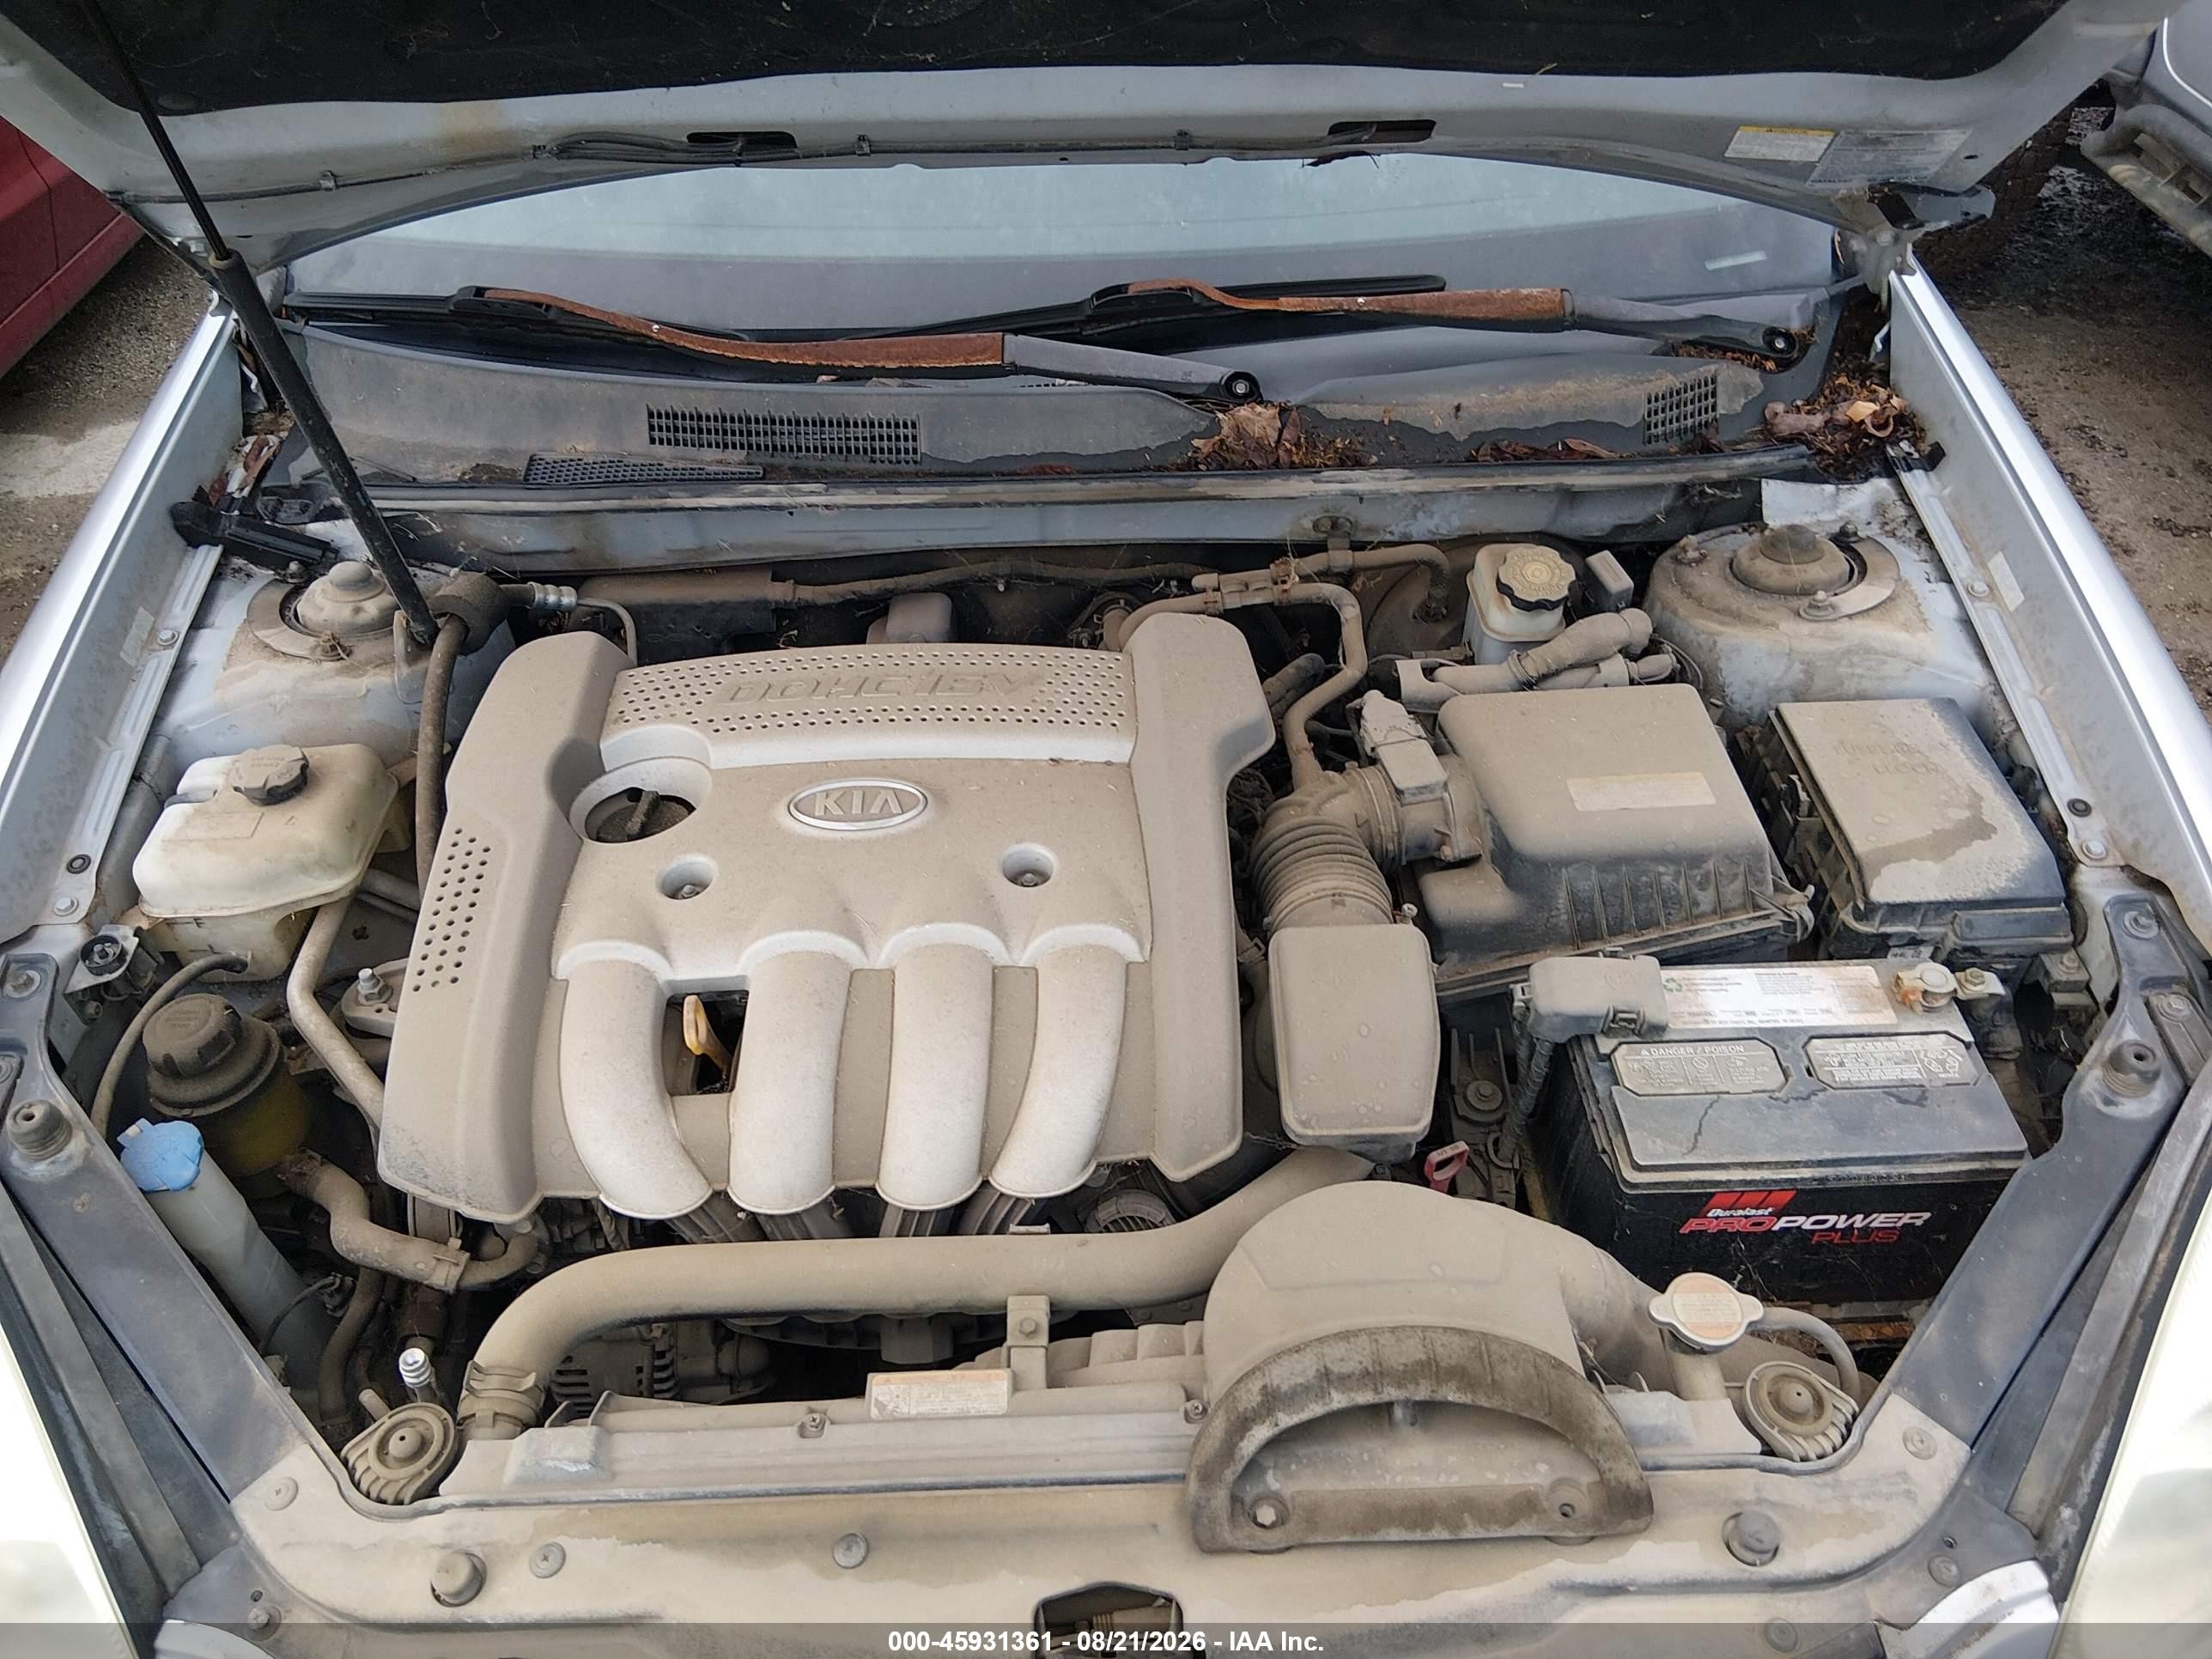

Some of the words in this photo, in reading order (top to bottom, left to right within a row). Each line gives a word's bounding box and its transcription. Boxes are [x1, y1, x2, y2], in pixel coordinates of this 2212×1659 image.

[814, 788, 902, 816] KIA
[1650, 1046, 1695, 1056] DANGER
[1704, 1044, 1745, 1054] POISON
[1705, 1207, 1775, 1218] Duralast
[1810, 1229, 1901, 1244] PLUS
